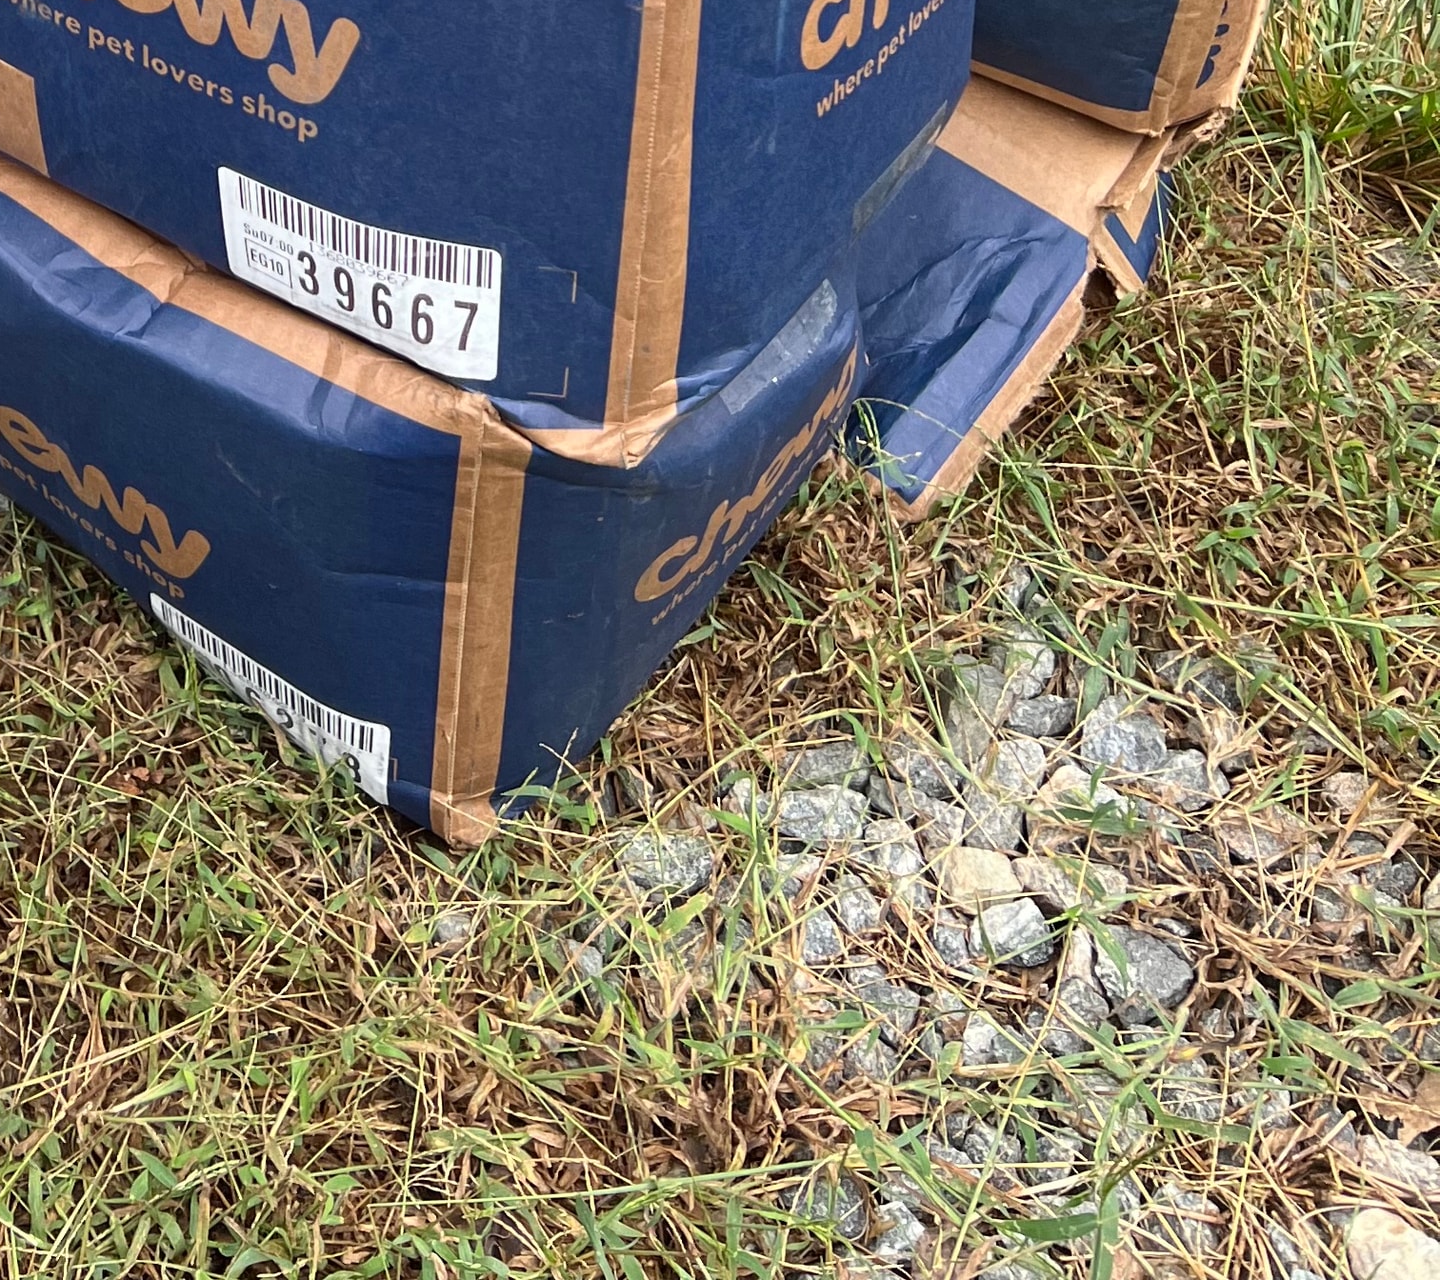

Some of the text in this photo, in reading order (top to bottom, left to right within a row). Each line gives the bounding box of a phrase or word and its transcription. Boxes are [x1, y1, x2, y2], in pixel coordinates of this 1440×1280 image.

[88, 24, 135, 63] pet
[142, 43, 235, 105] lovers
[241, 92, 318, 142] shop
[816, 58, 875, 118] where
[877, 24, 906, 75] pet
[250, 248, 284, 276] EG10
[296, 250, 478, 351] 39667
[41, 482, 119, 552] lovers
[123, 546, 185, 600] shop
